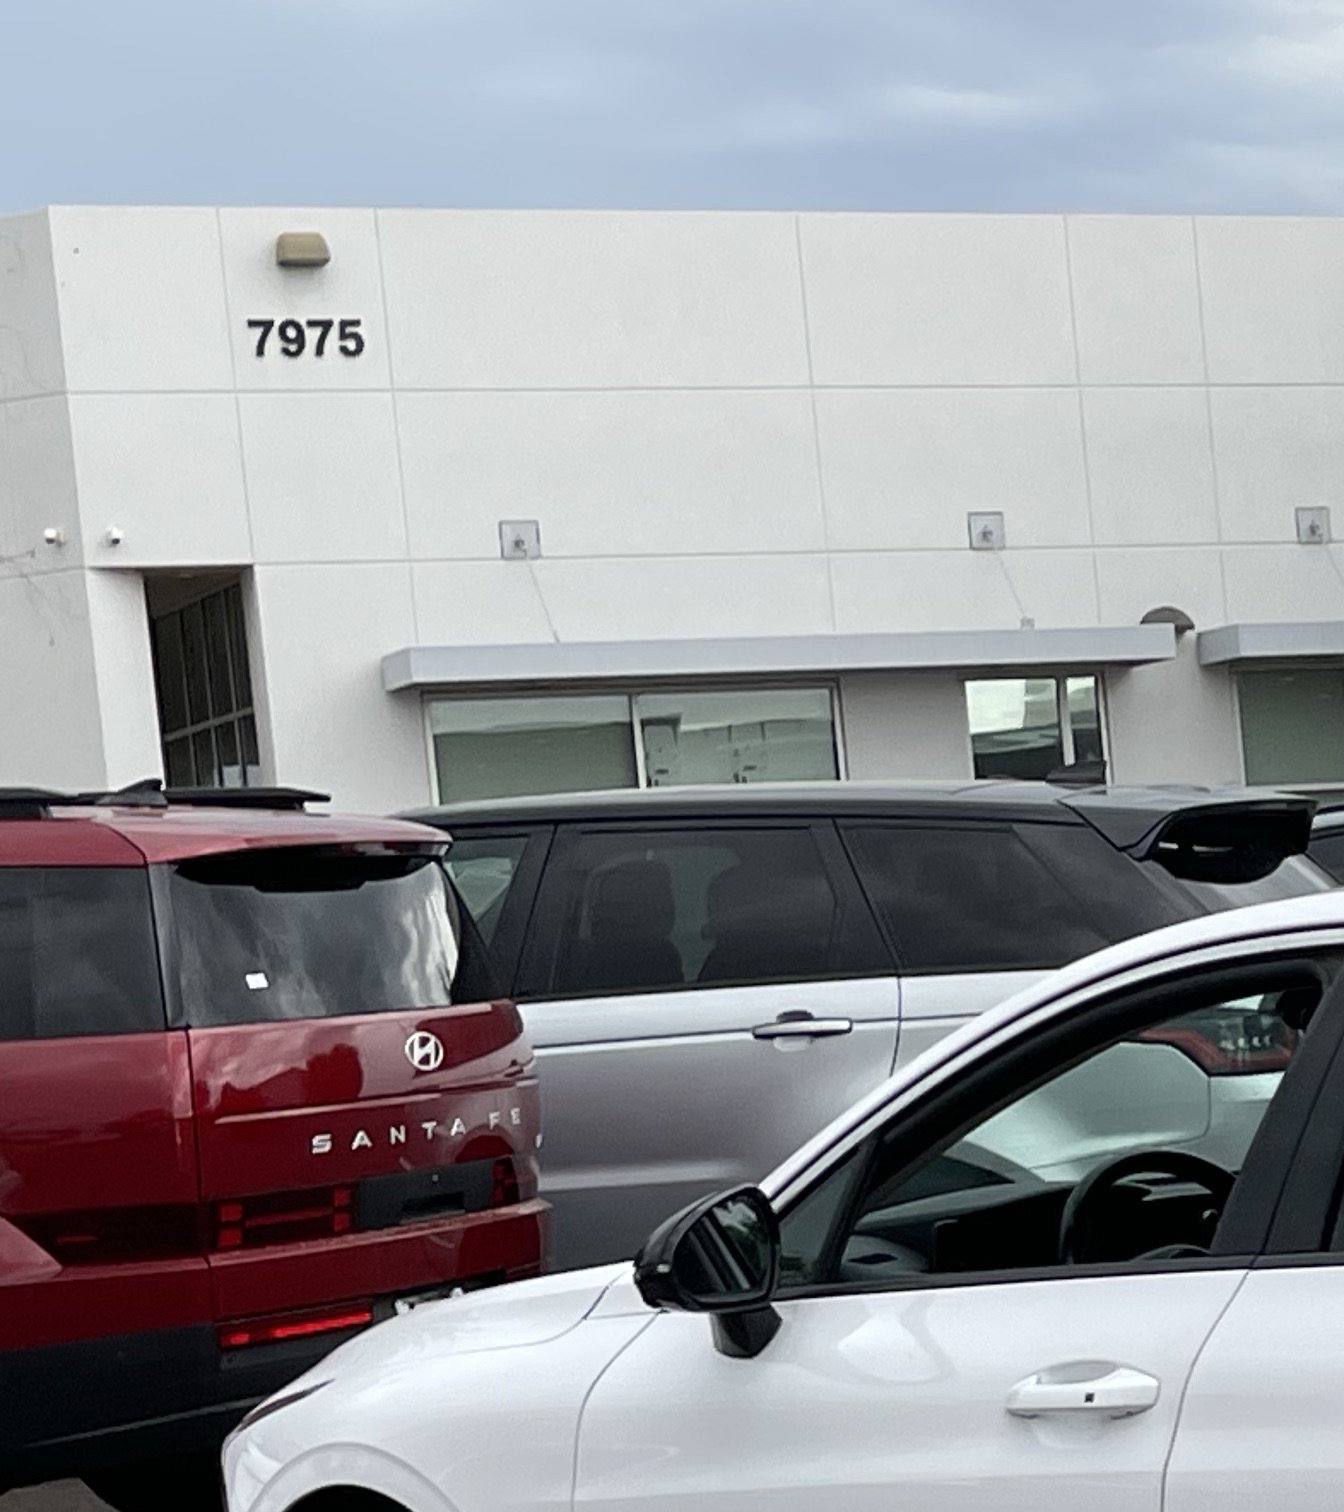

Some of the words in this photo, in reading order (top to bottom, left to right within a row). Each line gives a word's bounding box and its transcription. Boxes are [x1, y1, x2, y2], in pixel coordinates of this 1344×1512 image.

[247, 318, 365, 358] 7975
[312, 1118, 466, 1154] SANTA
[488, 1108, 521, 1129] FE
